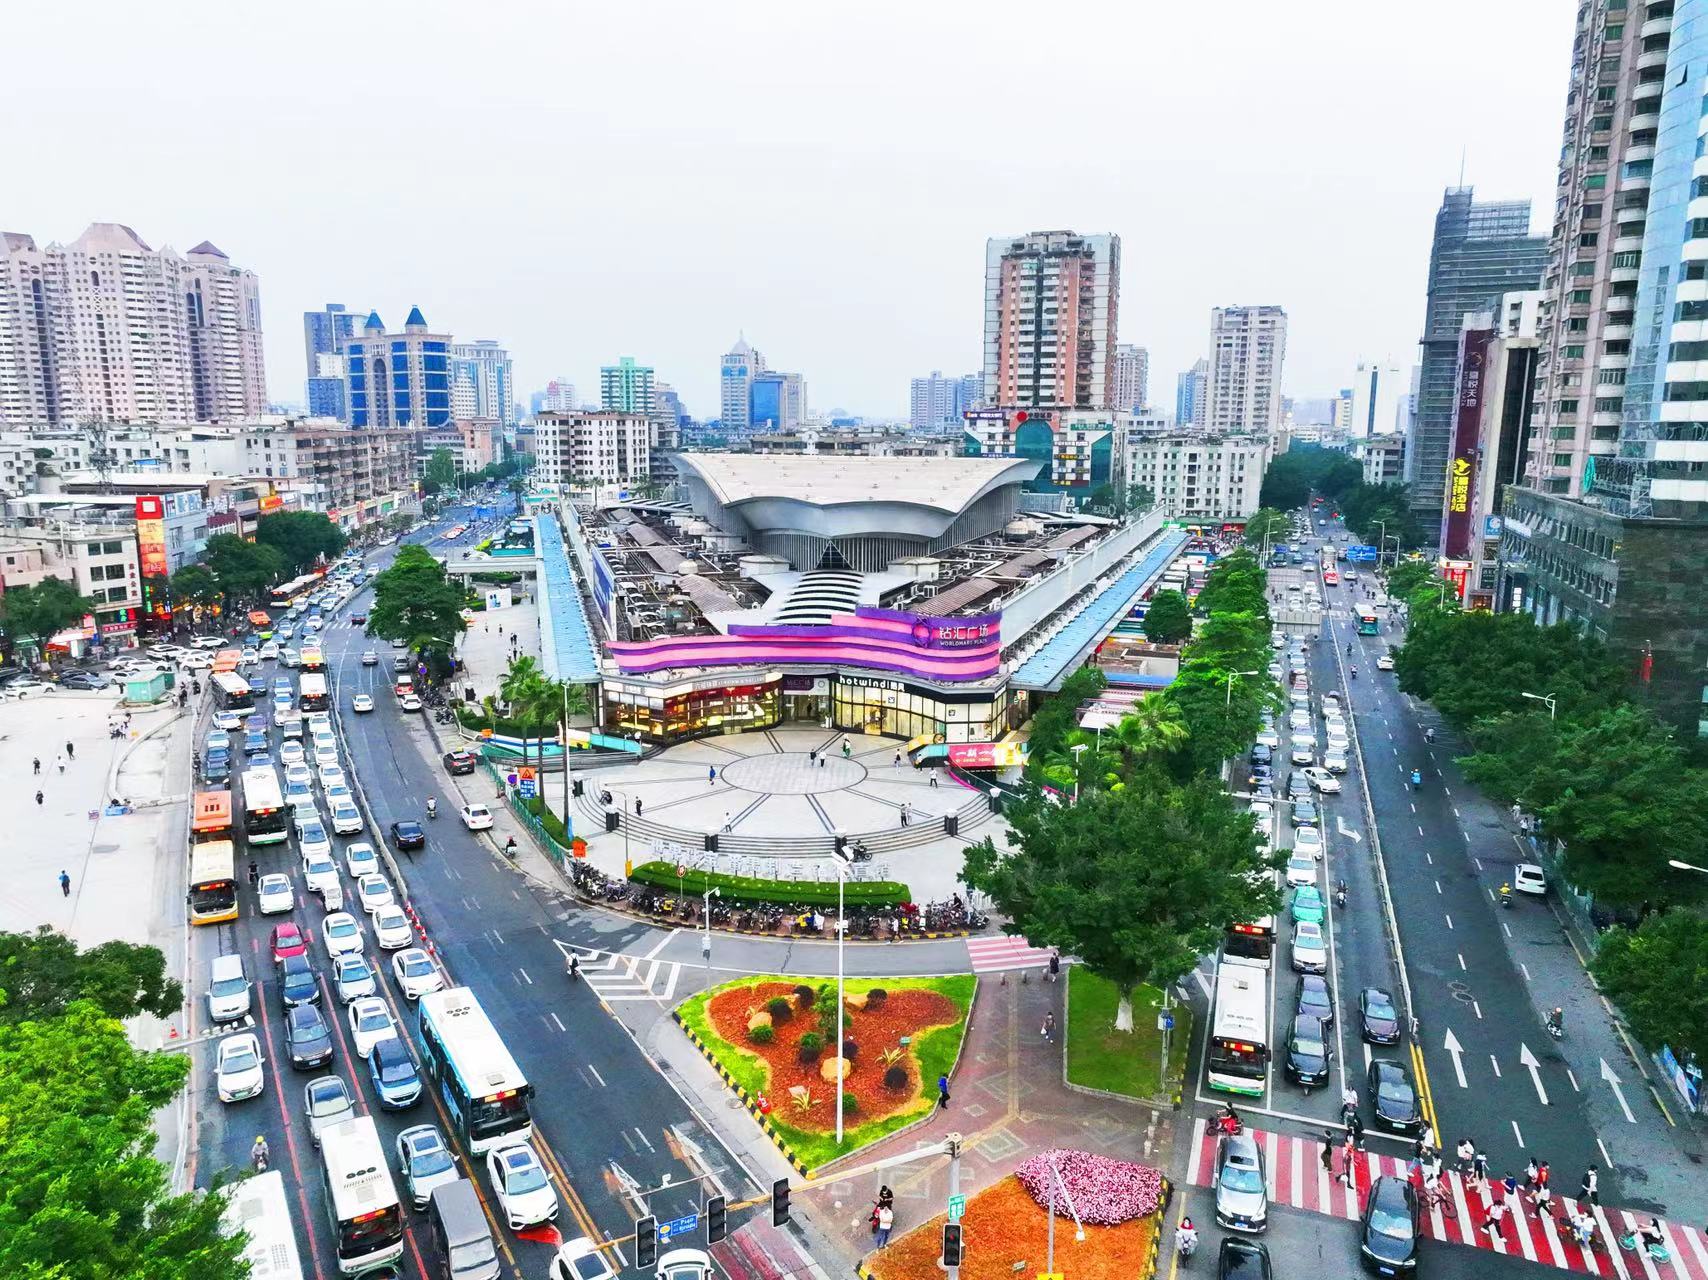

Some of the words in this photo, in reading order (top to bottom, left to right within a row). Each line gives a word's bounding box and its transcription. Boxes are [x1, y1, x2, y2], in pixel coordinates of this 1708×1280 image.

[939, 624, 989, 640] 钻汇广场
[840, 675, 886, 689] hotwind
